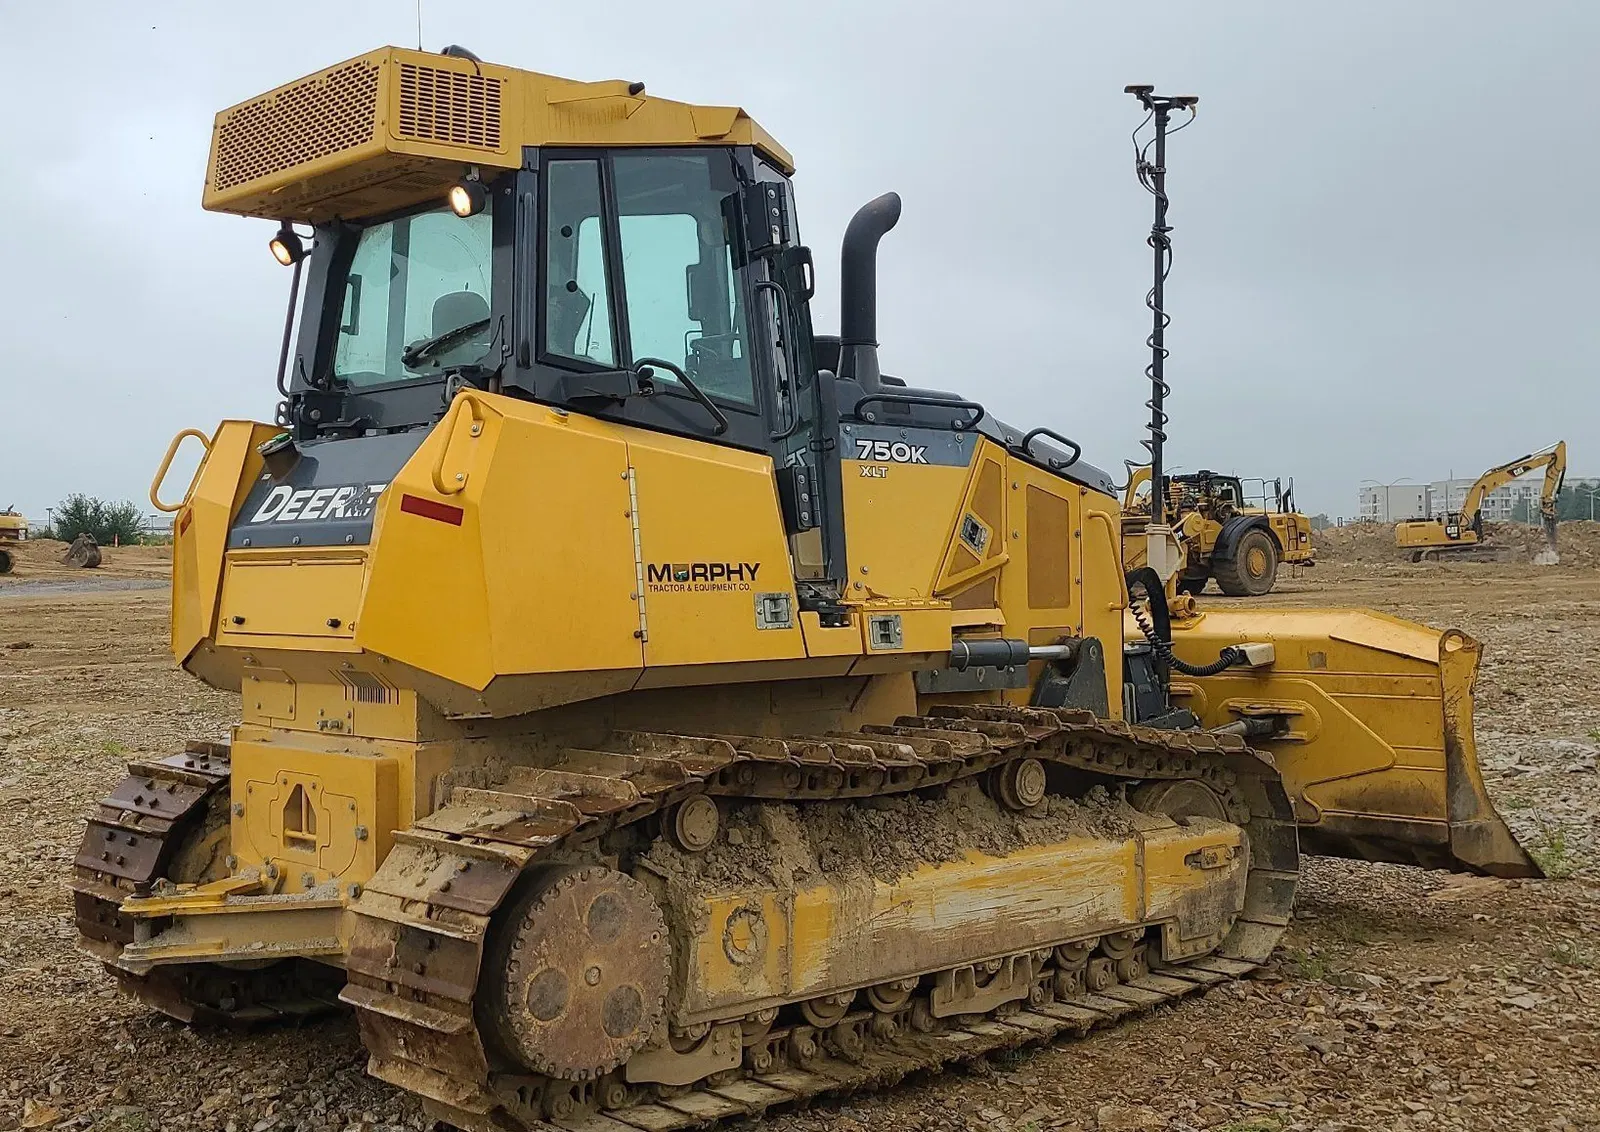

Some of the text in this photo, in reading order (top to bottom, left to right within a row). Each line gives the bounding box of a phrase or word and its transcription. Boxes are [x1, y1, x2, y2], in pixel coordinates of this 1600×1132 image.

[855, 439, 929, 464] 750K
[860, 465, 888, 478] XLT
[647, 563, 760, 583] MURPHY
[648, 583, 752, 592] TRACTOR & EQUIPMENT CO.
